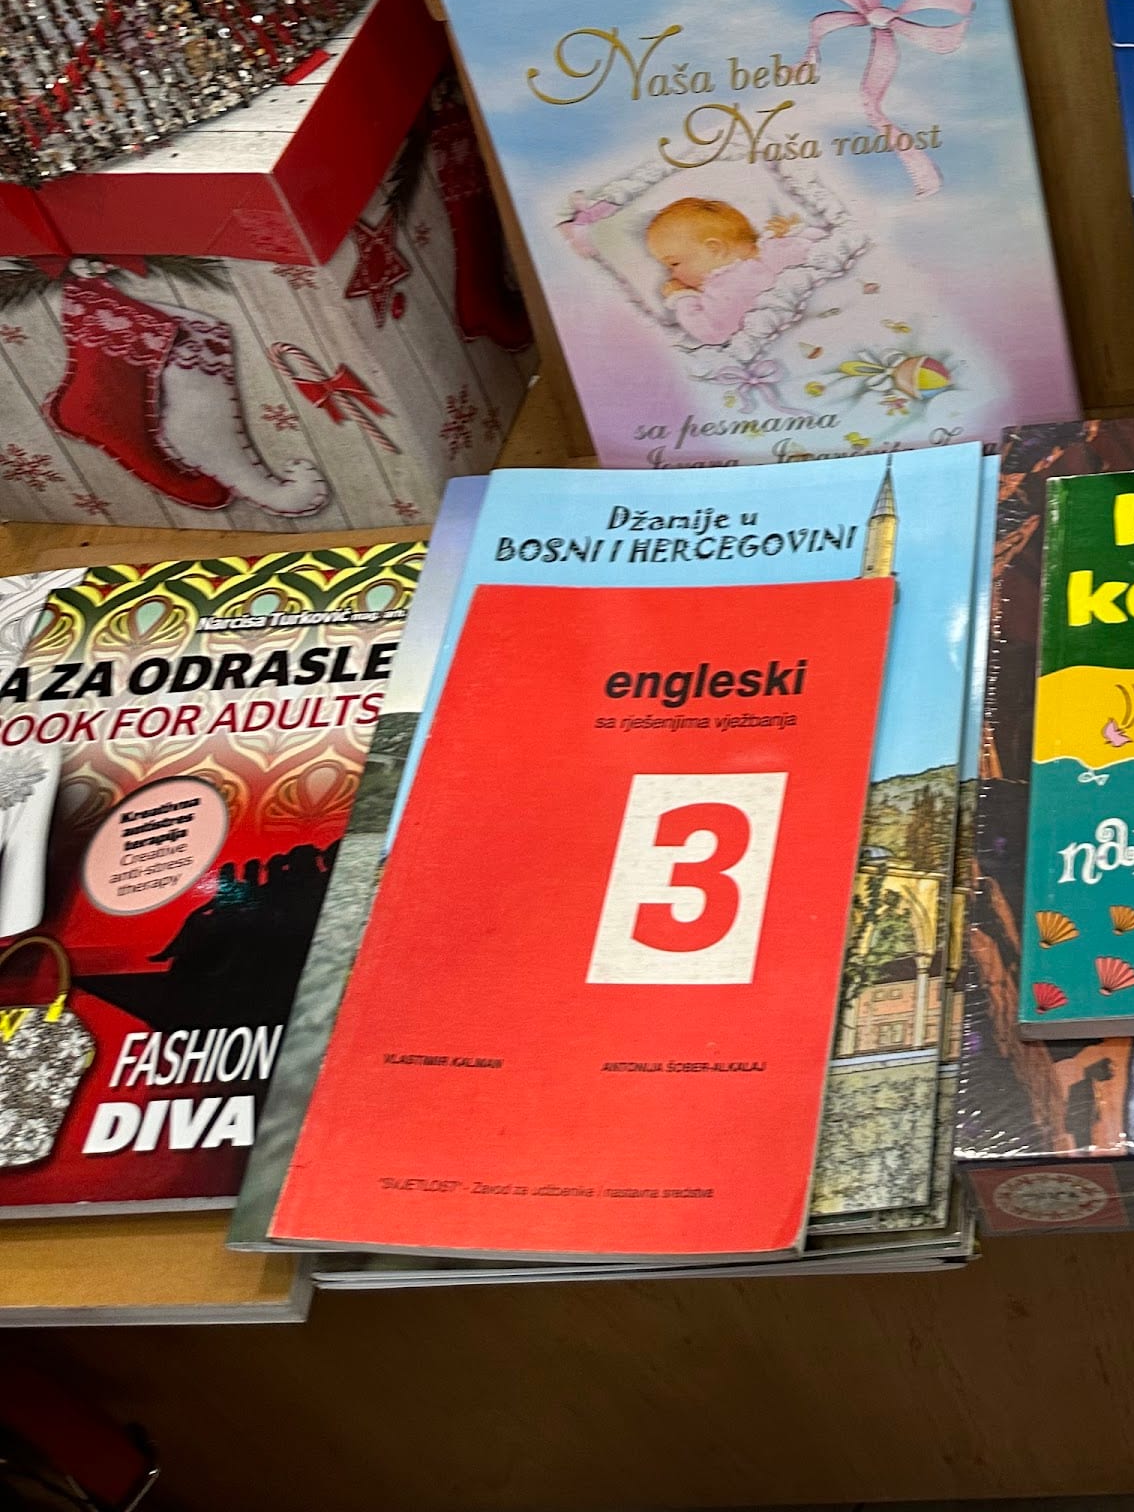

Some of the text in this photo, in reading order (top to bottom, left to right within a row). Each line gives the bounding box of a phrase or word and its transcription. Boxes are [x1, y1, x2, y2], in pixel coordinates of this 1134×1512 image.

[525, 23, 821, 106] Naša beba
[659, 99, 944, 170] Naša radost
[633, 411, 842, 450] sa pesmama
[606, 504, 759, 536] Džamije u
[495, 525, 859, 564] BOSNI I HERCEGOVINI
[199, 612, 269, 633] Narcisa
[268, 609, 351, 628] Turković
[38, 661, 115, 702] ZA
[126, 641, 400, 697] ODRASLE
[603, 659, 809, 709] engleski
[107, 703, 203, 741] FOR
[206, 692, 386, 736] ADULTS
[594, 712, 798, 733] sa rješenjima vježbanja
[119, 797, 202, 824] Kreativna
[108, 855, 195, 884] anti-stress
[119, 843, 189, 866] Creative
[116, 873, 183, 897] therapy
[628, 801, 753, 954] 3
[107, 1023, 284, 1088] FASHION
[81, 1093, 258, 1156] DIVA
